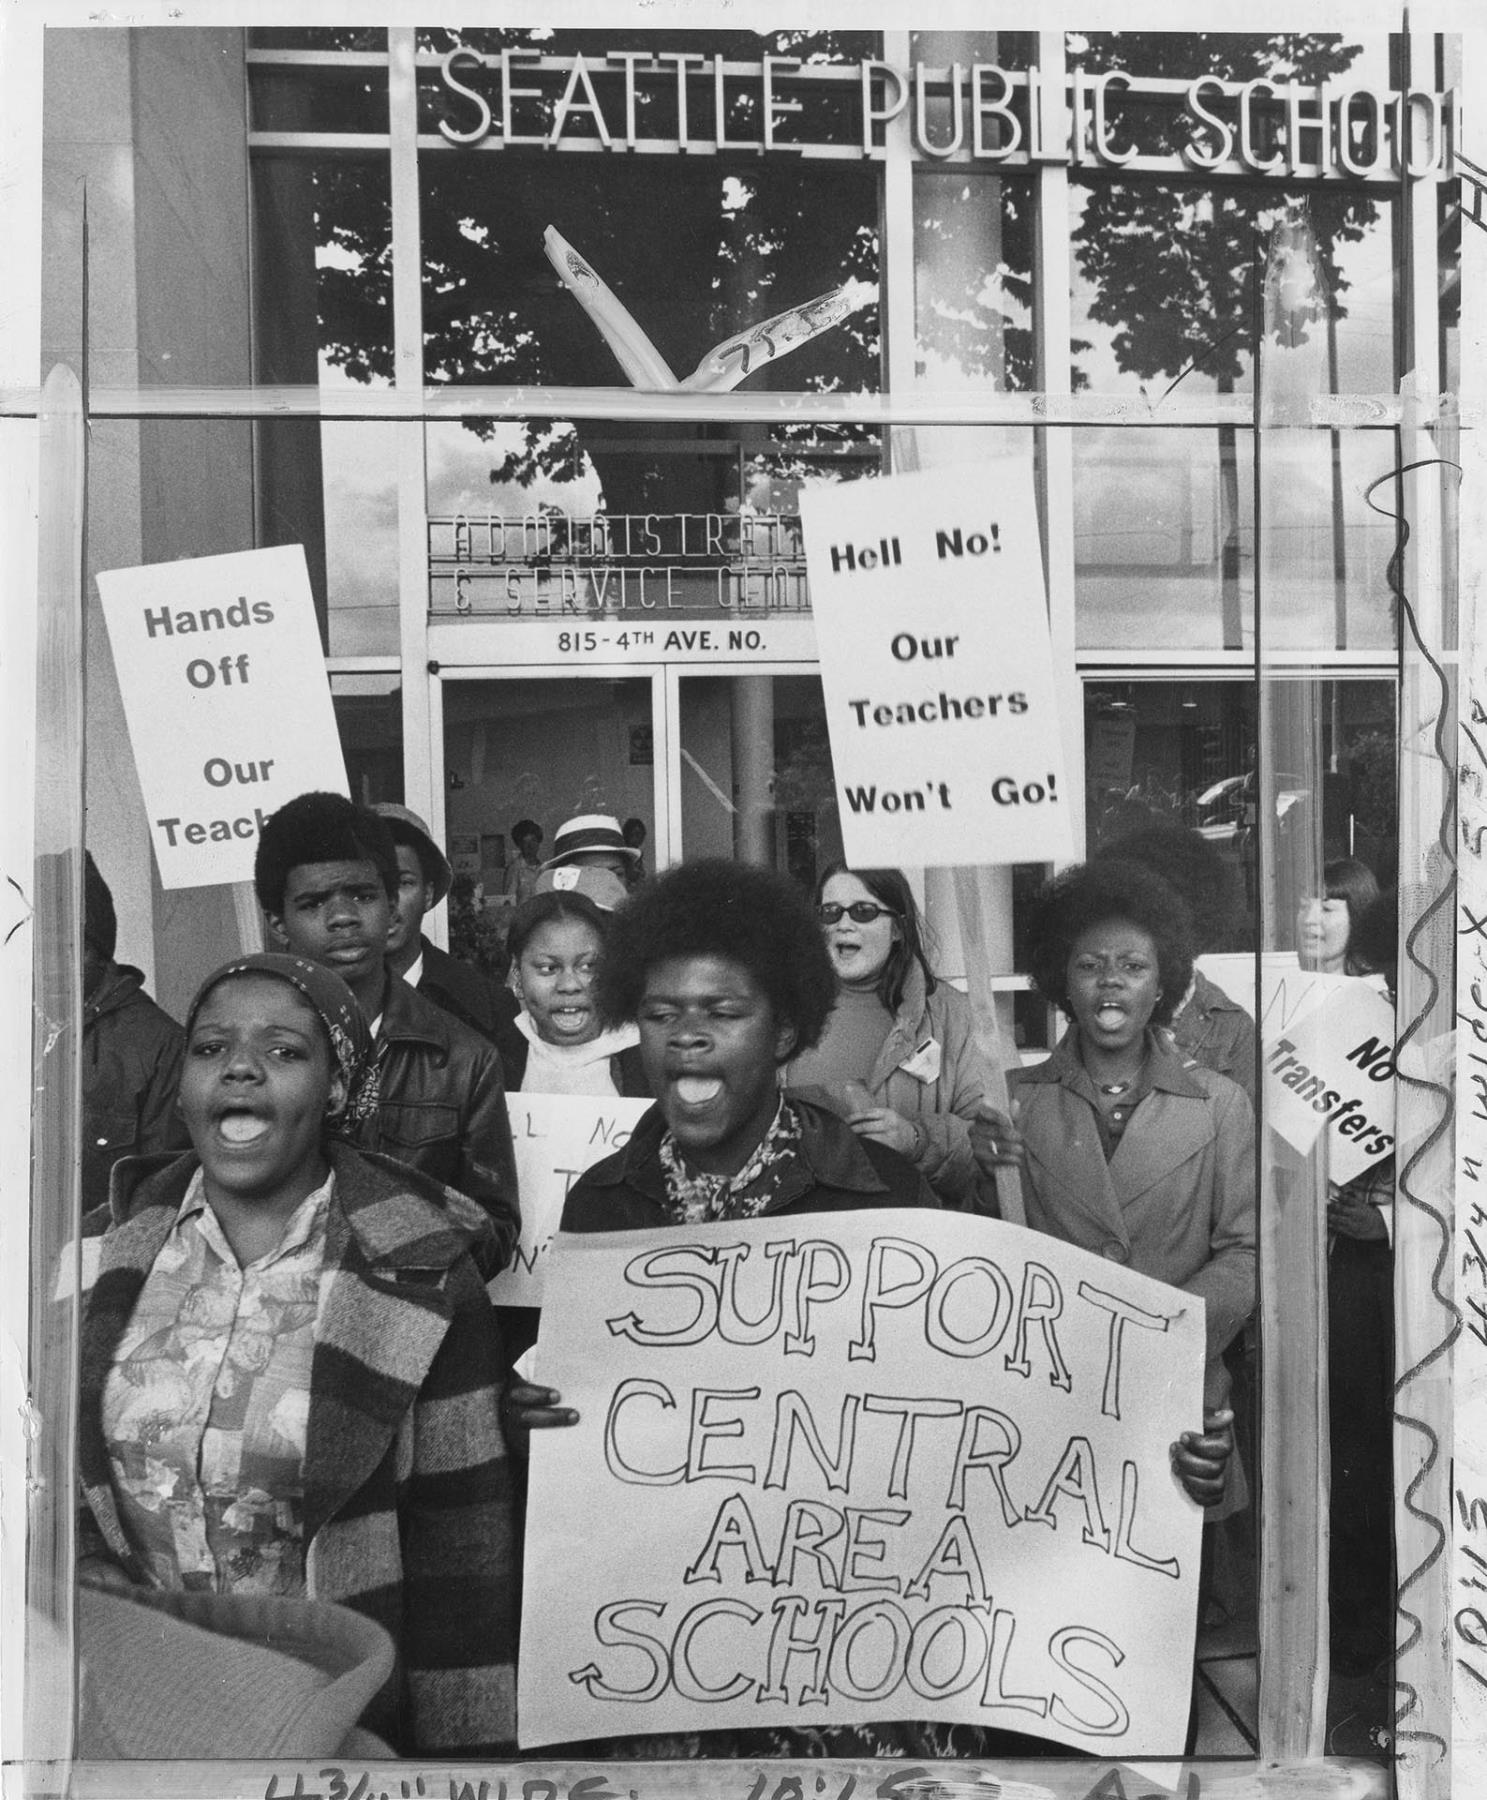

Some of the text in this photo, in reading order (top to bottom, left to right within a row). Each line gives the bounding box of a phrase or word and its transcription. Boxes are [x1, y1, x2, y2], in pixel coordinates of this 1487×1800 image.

[438, 46, 803, 153] SEATTLE
[861, 59, 1139, 167] PUBLIC
[830, 522, 1002, 573] Hell No!
[505, 566, 683, 610] SERVICE
[143, 596, 275, 639] Hands
[663, 631, 719, 652] AVE.
[728, 630, 767, 651] NO.
[890, 631, 960, 662] Our
[185, 653, 251, 690] Off
[848, 690, 1030, 728] Teachers
[203, 757, 276, 788] Our
[844, 773, 1059, 814] Won't Go!
[1346, 1035, 1396, 1083] No
[1266, 1037, 1395, 1156] Transfers
[606, 1236, 1174, 1421] SUPPORT
[604, 1378, 1180, 1578] CENTRAL
[683, 1493, 994, 1610] AREA
[568, 1596, 1130, 1737] SCHOOLS
